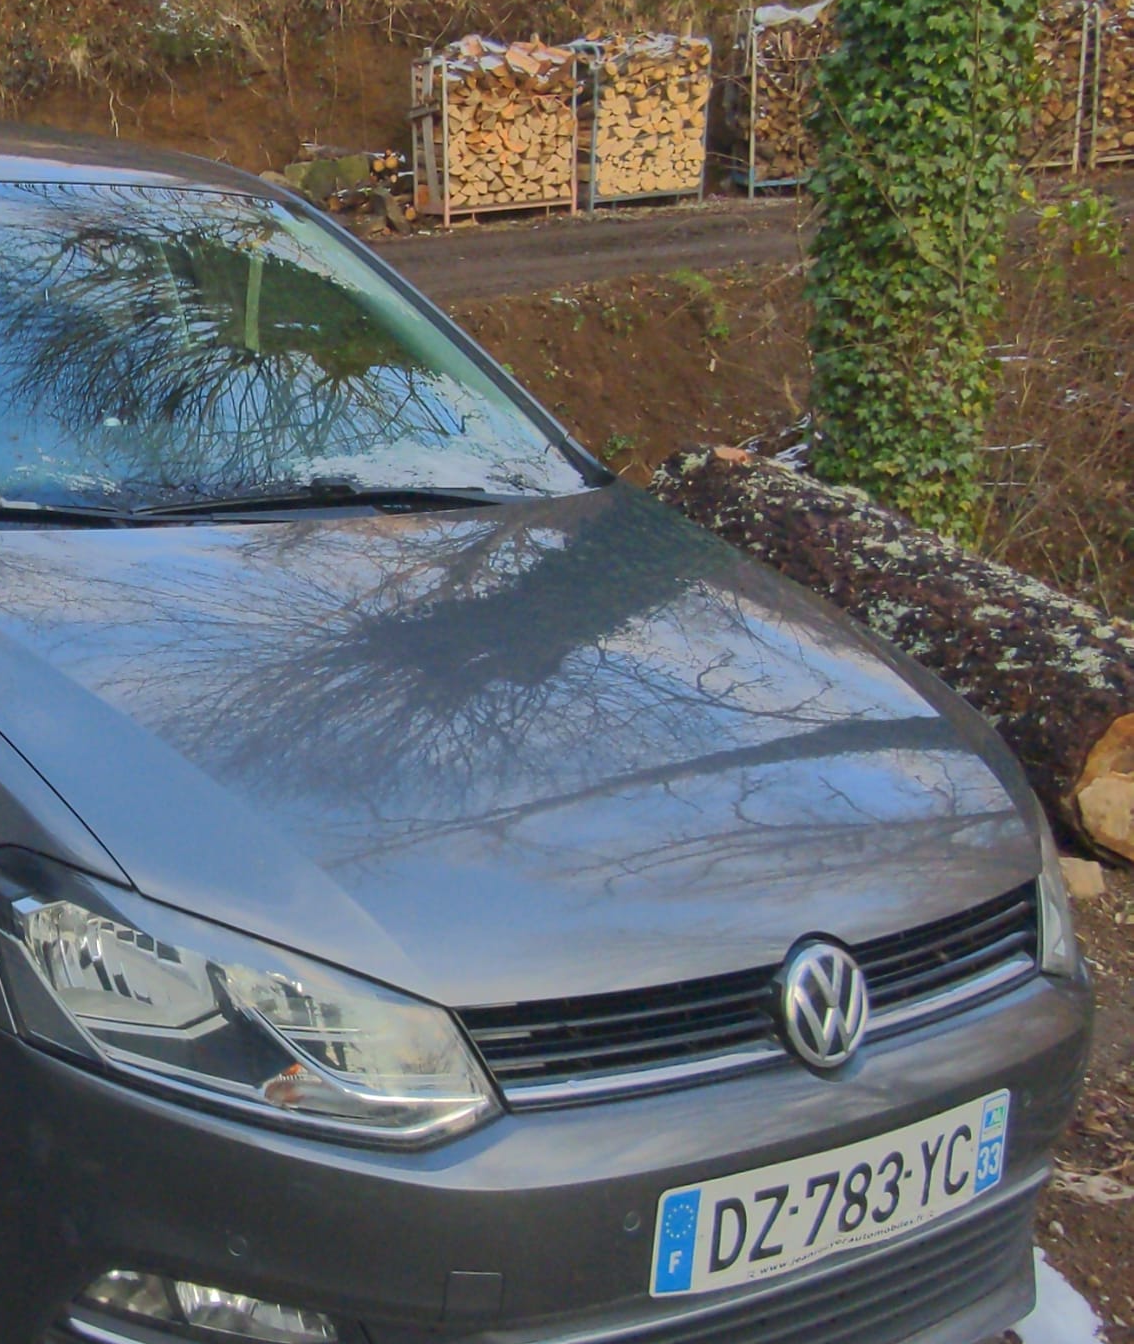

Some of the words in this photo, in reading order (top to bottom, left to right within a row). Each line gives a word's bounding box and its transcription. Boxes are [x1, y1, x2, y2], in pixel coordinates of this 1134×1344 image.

[787, 947, 867, 1065] VW
[708, 1123, 972, 1274] DZ-783-YC
[977, 1141, 1002, 1181] 33
[667, 1250, 682, 1275] F
